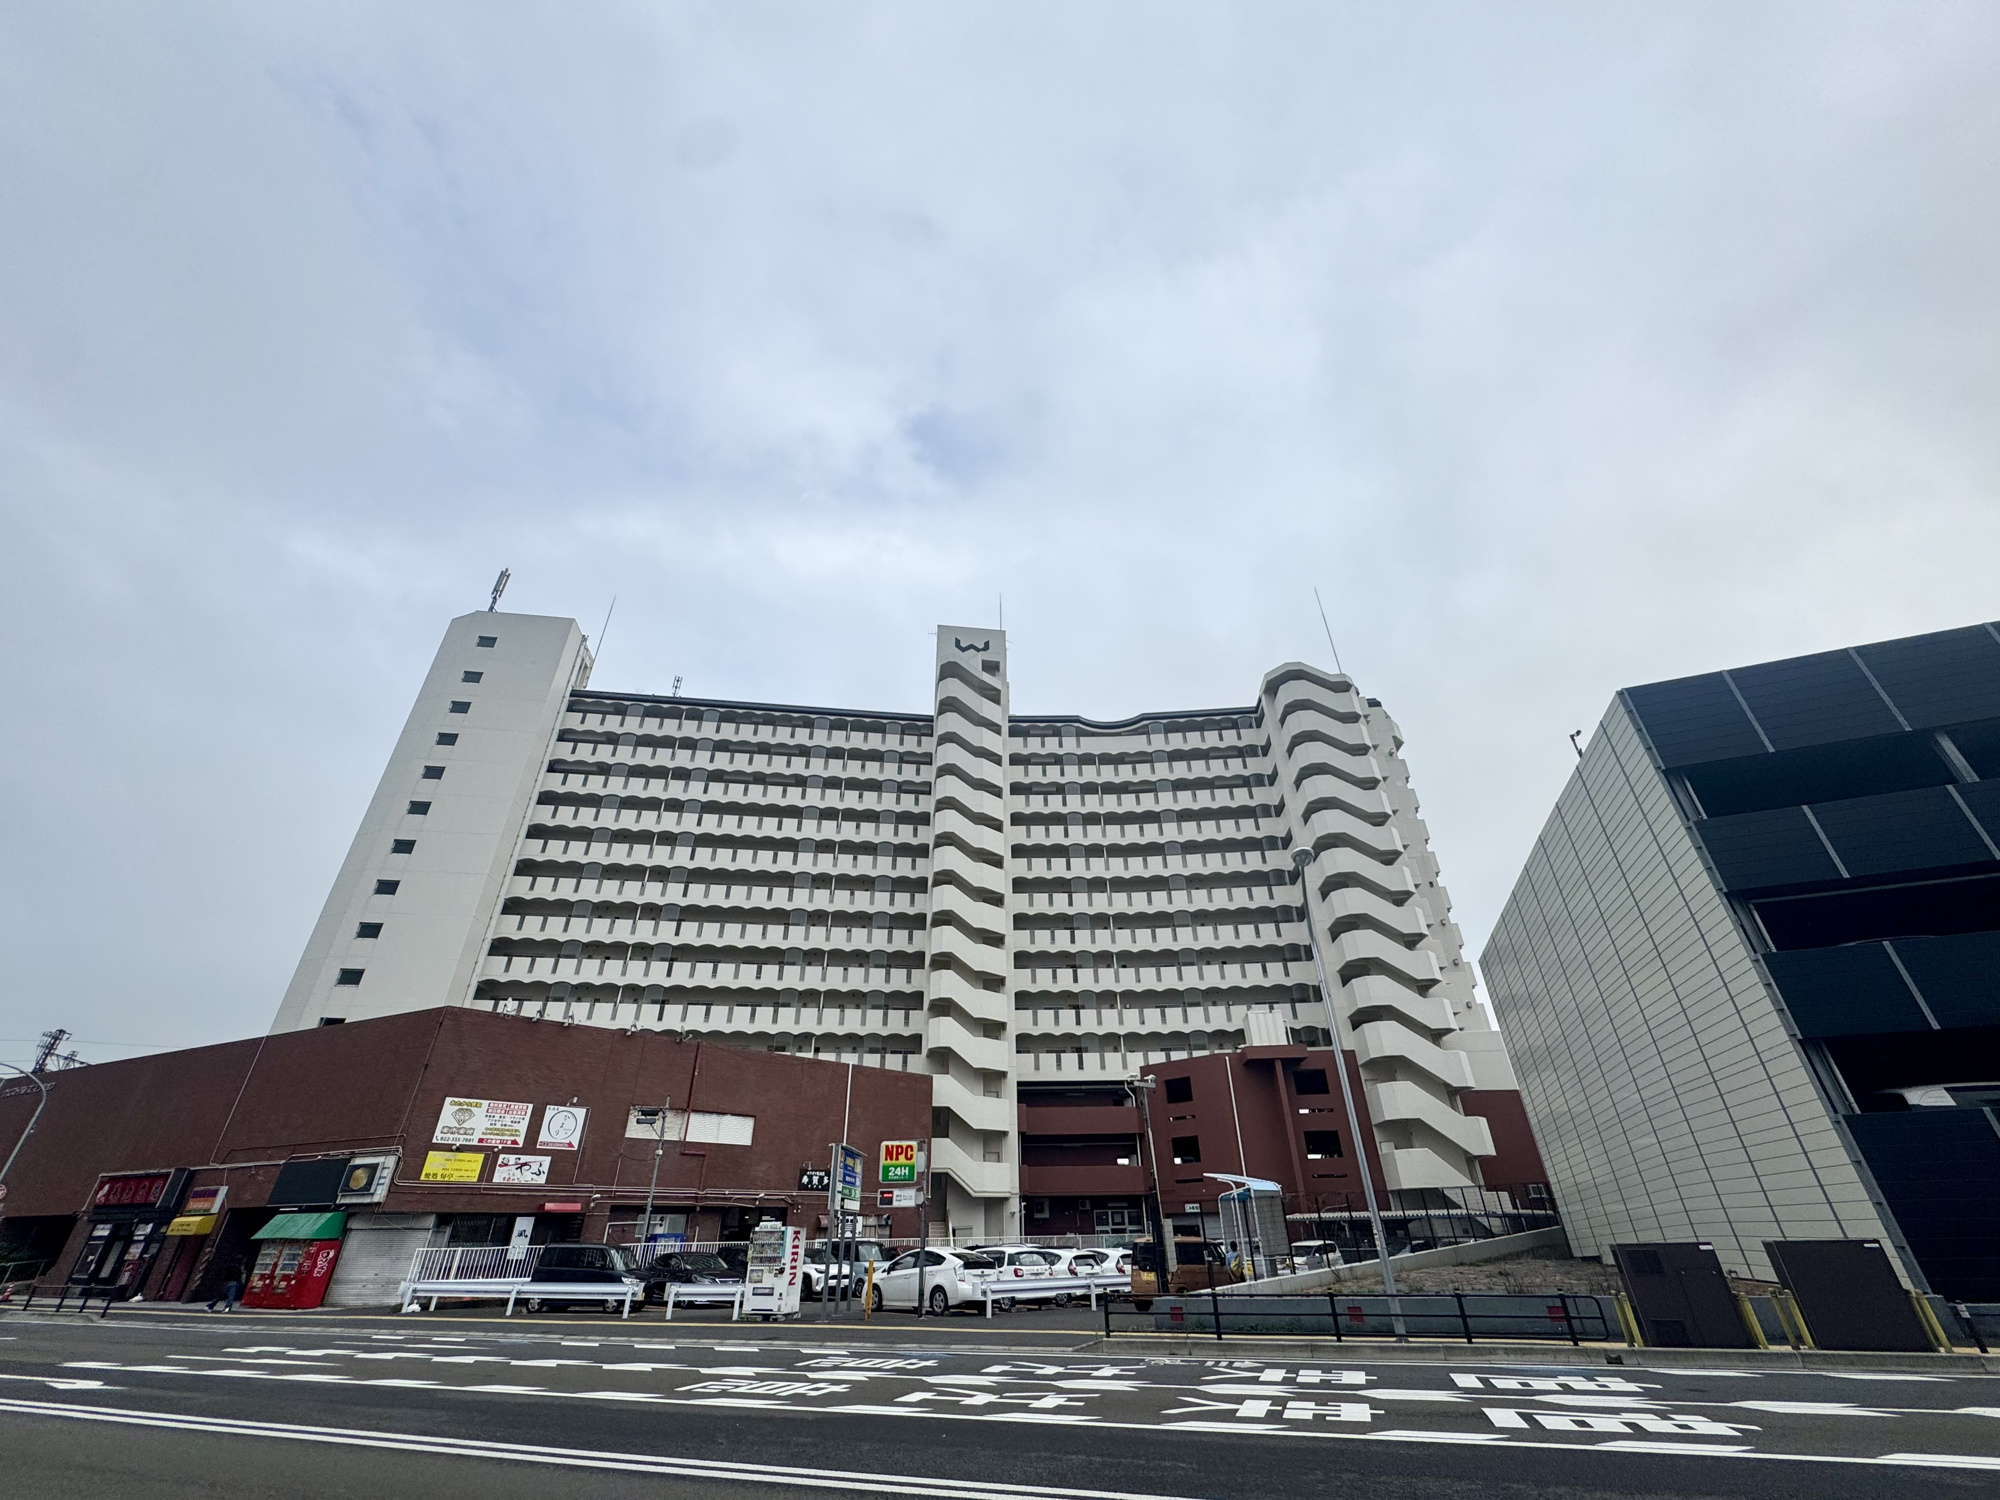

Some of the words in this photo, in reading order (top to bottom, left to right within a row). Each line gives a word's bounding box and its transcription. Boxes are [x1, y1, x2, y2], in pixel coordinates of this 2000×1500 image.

[884, 1144, 914, 1162] NPC
[888, 1166, 909, 1176] 24H
[788, 1230, 801, 1286] KIRIN
